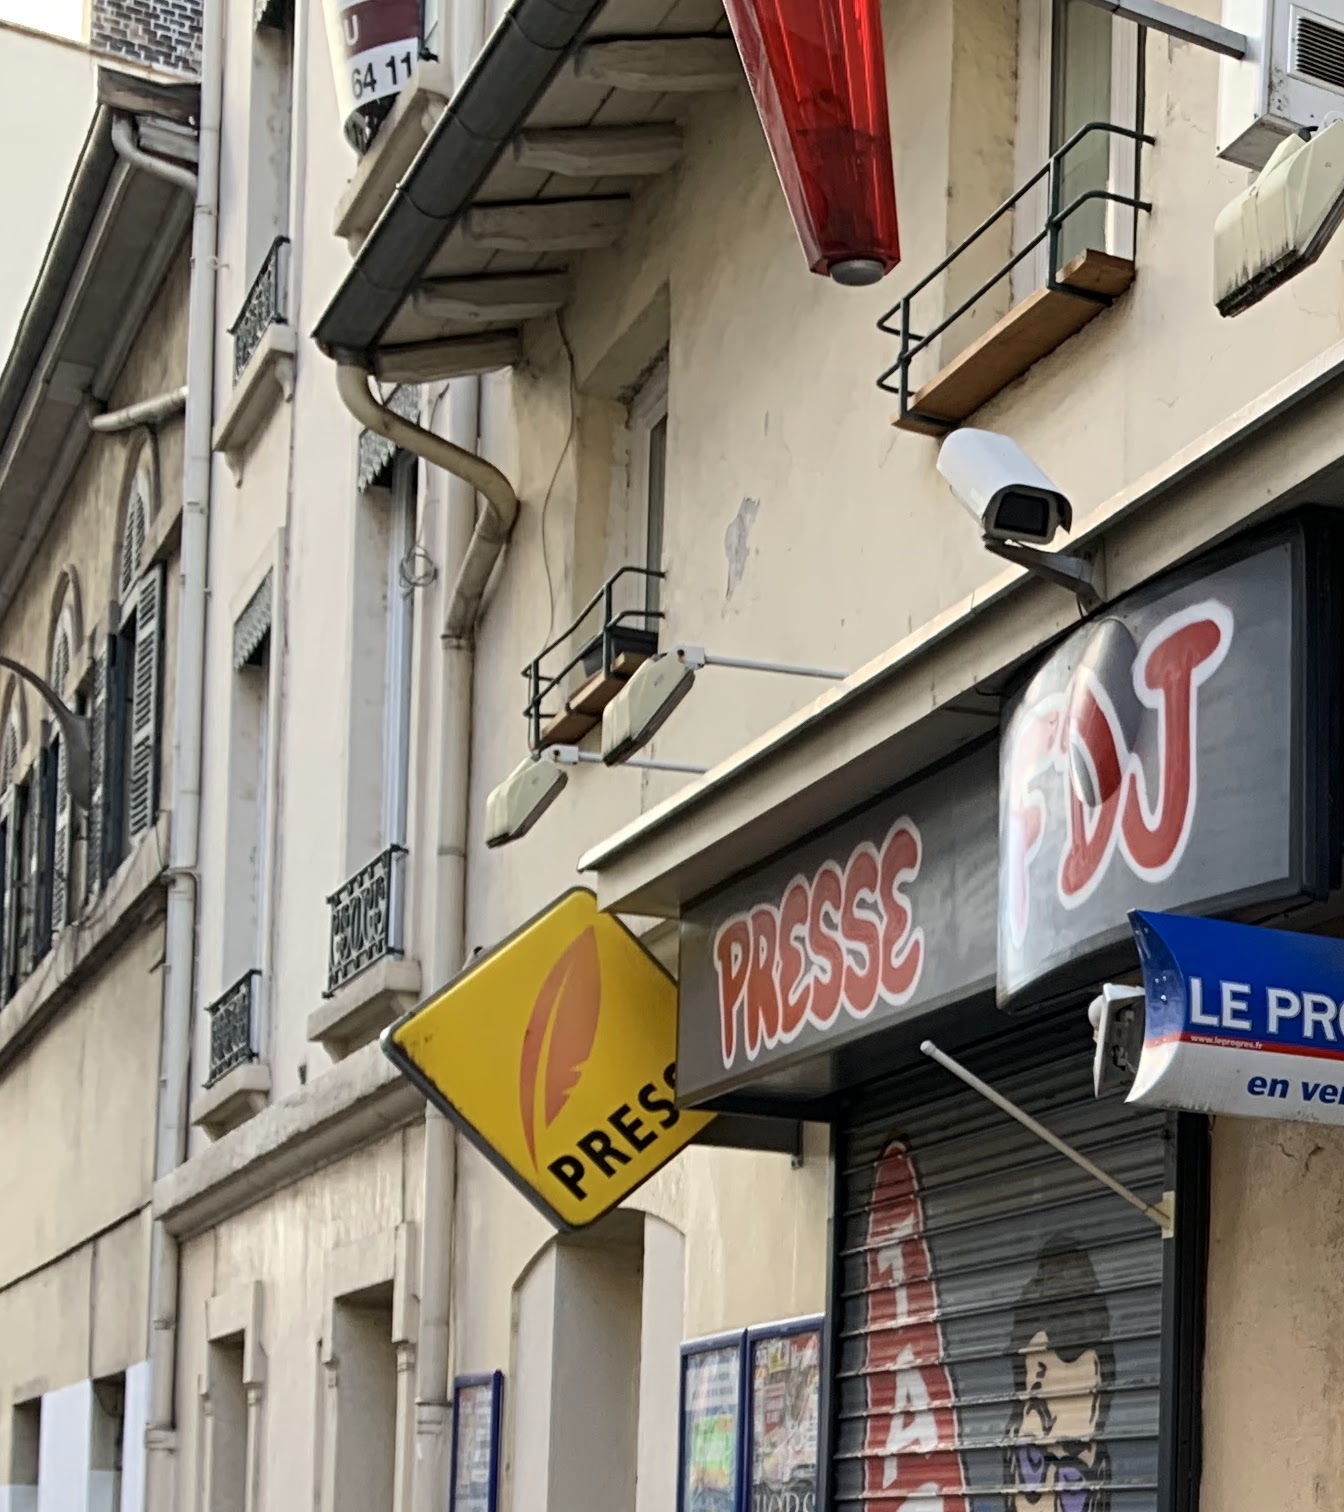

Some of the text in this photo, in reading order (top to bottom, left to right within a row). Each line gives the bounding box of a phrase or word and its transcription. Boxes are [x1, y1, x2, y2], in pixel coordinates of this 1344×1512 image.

[352, 51, 411, 99] 64 11
[1007, 599, 1234, 950] FDJ
[714, 816, 925, 1069] PRESSE
[1189, 976, 1252, 1031] LE
[1246, 1075, 1289, 1098] en
